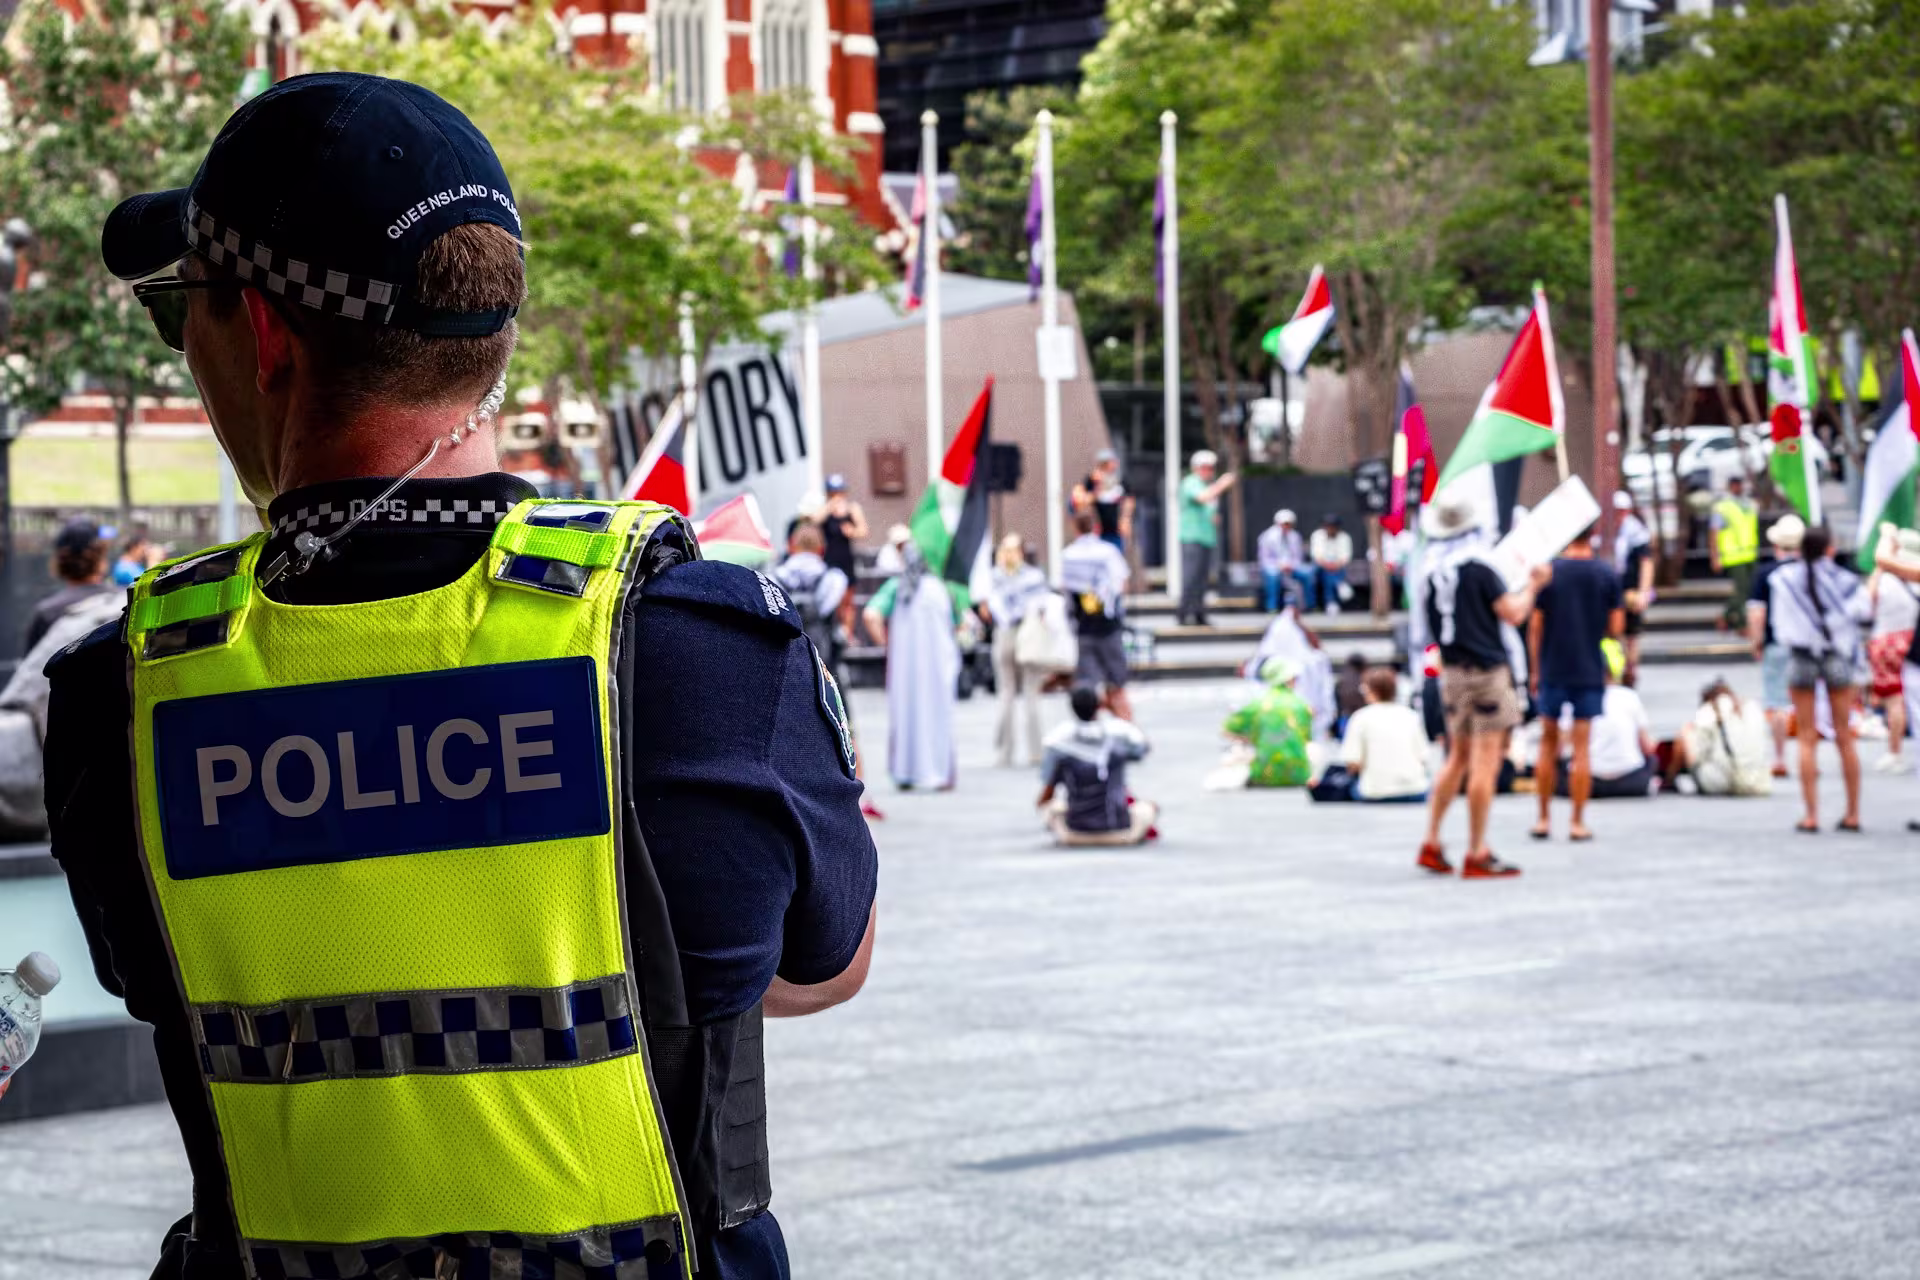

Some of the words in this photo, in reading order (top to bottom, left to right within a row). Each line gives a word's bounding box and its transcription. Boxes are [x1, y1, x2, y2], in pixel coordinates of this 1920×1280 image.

[386, 184, 488, 240] QUEENSLAND
[349, 498, 407, 522] QPS
[195, 709, 562, 826] POLICE
